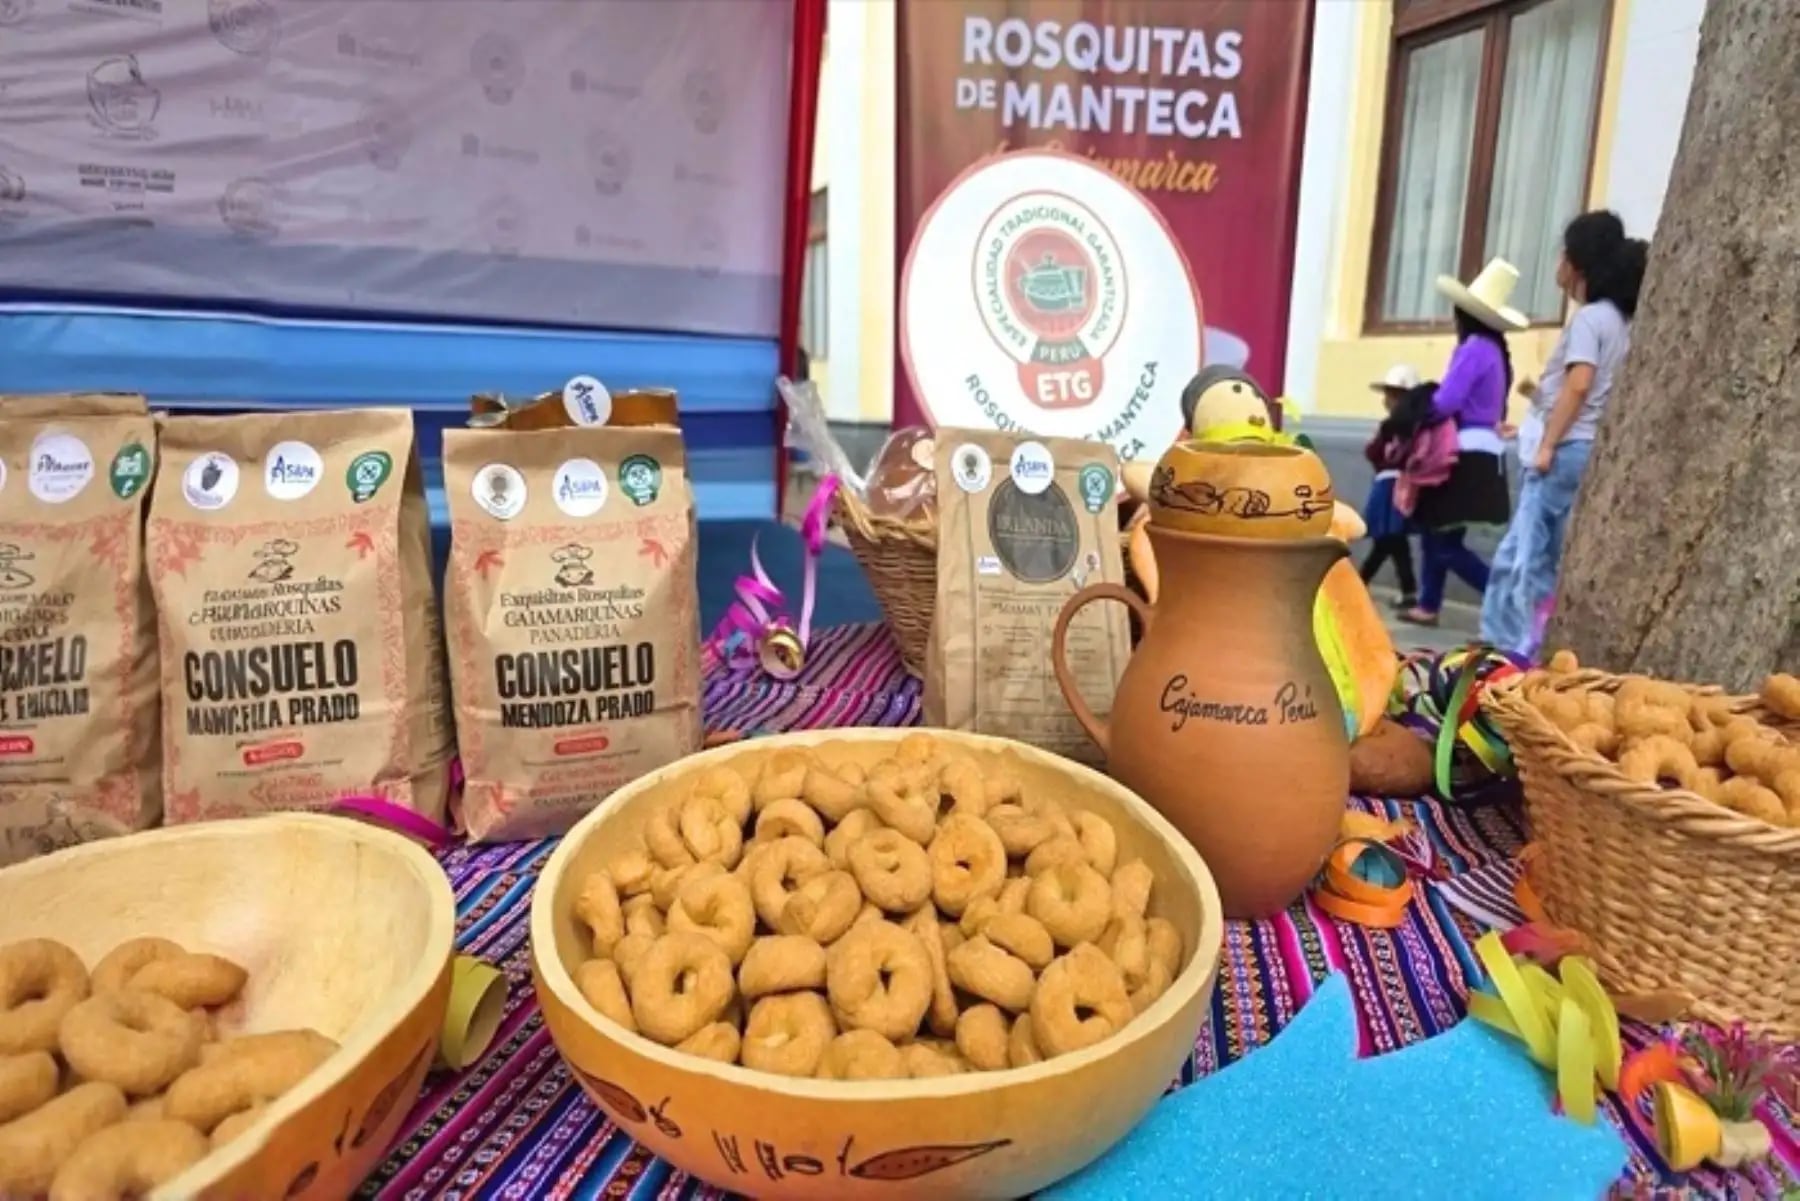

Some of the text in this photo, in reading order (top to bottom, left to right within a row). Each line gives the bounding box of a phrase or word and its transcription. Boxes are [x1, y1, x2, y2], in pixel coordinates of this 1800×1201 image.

[963, 17, 1243, 79] ROSQUITAS
[955, 78, 1242, 138] DE MANTECA
[999, 205, 1085, 237] TRADICIONAL
[1037, 370, 1093, 402] ETG
[1097, 360, 1159, 442] MANTECA
[184, 639, 358, 701] CONSUELO
[495, 642, 655, 698] CONSUELO
[289, 693, 360, 725] PRADO
[502, 690, 654, 728] MENDOZA PRADO
[1160, 674, 1319, 732] Cajamarca Perú
